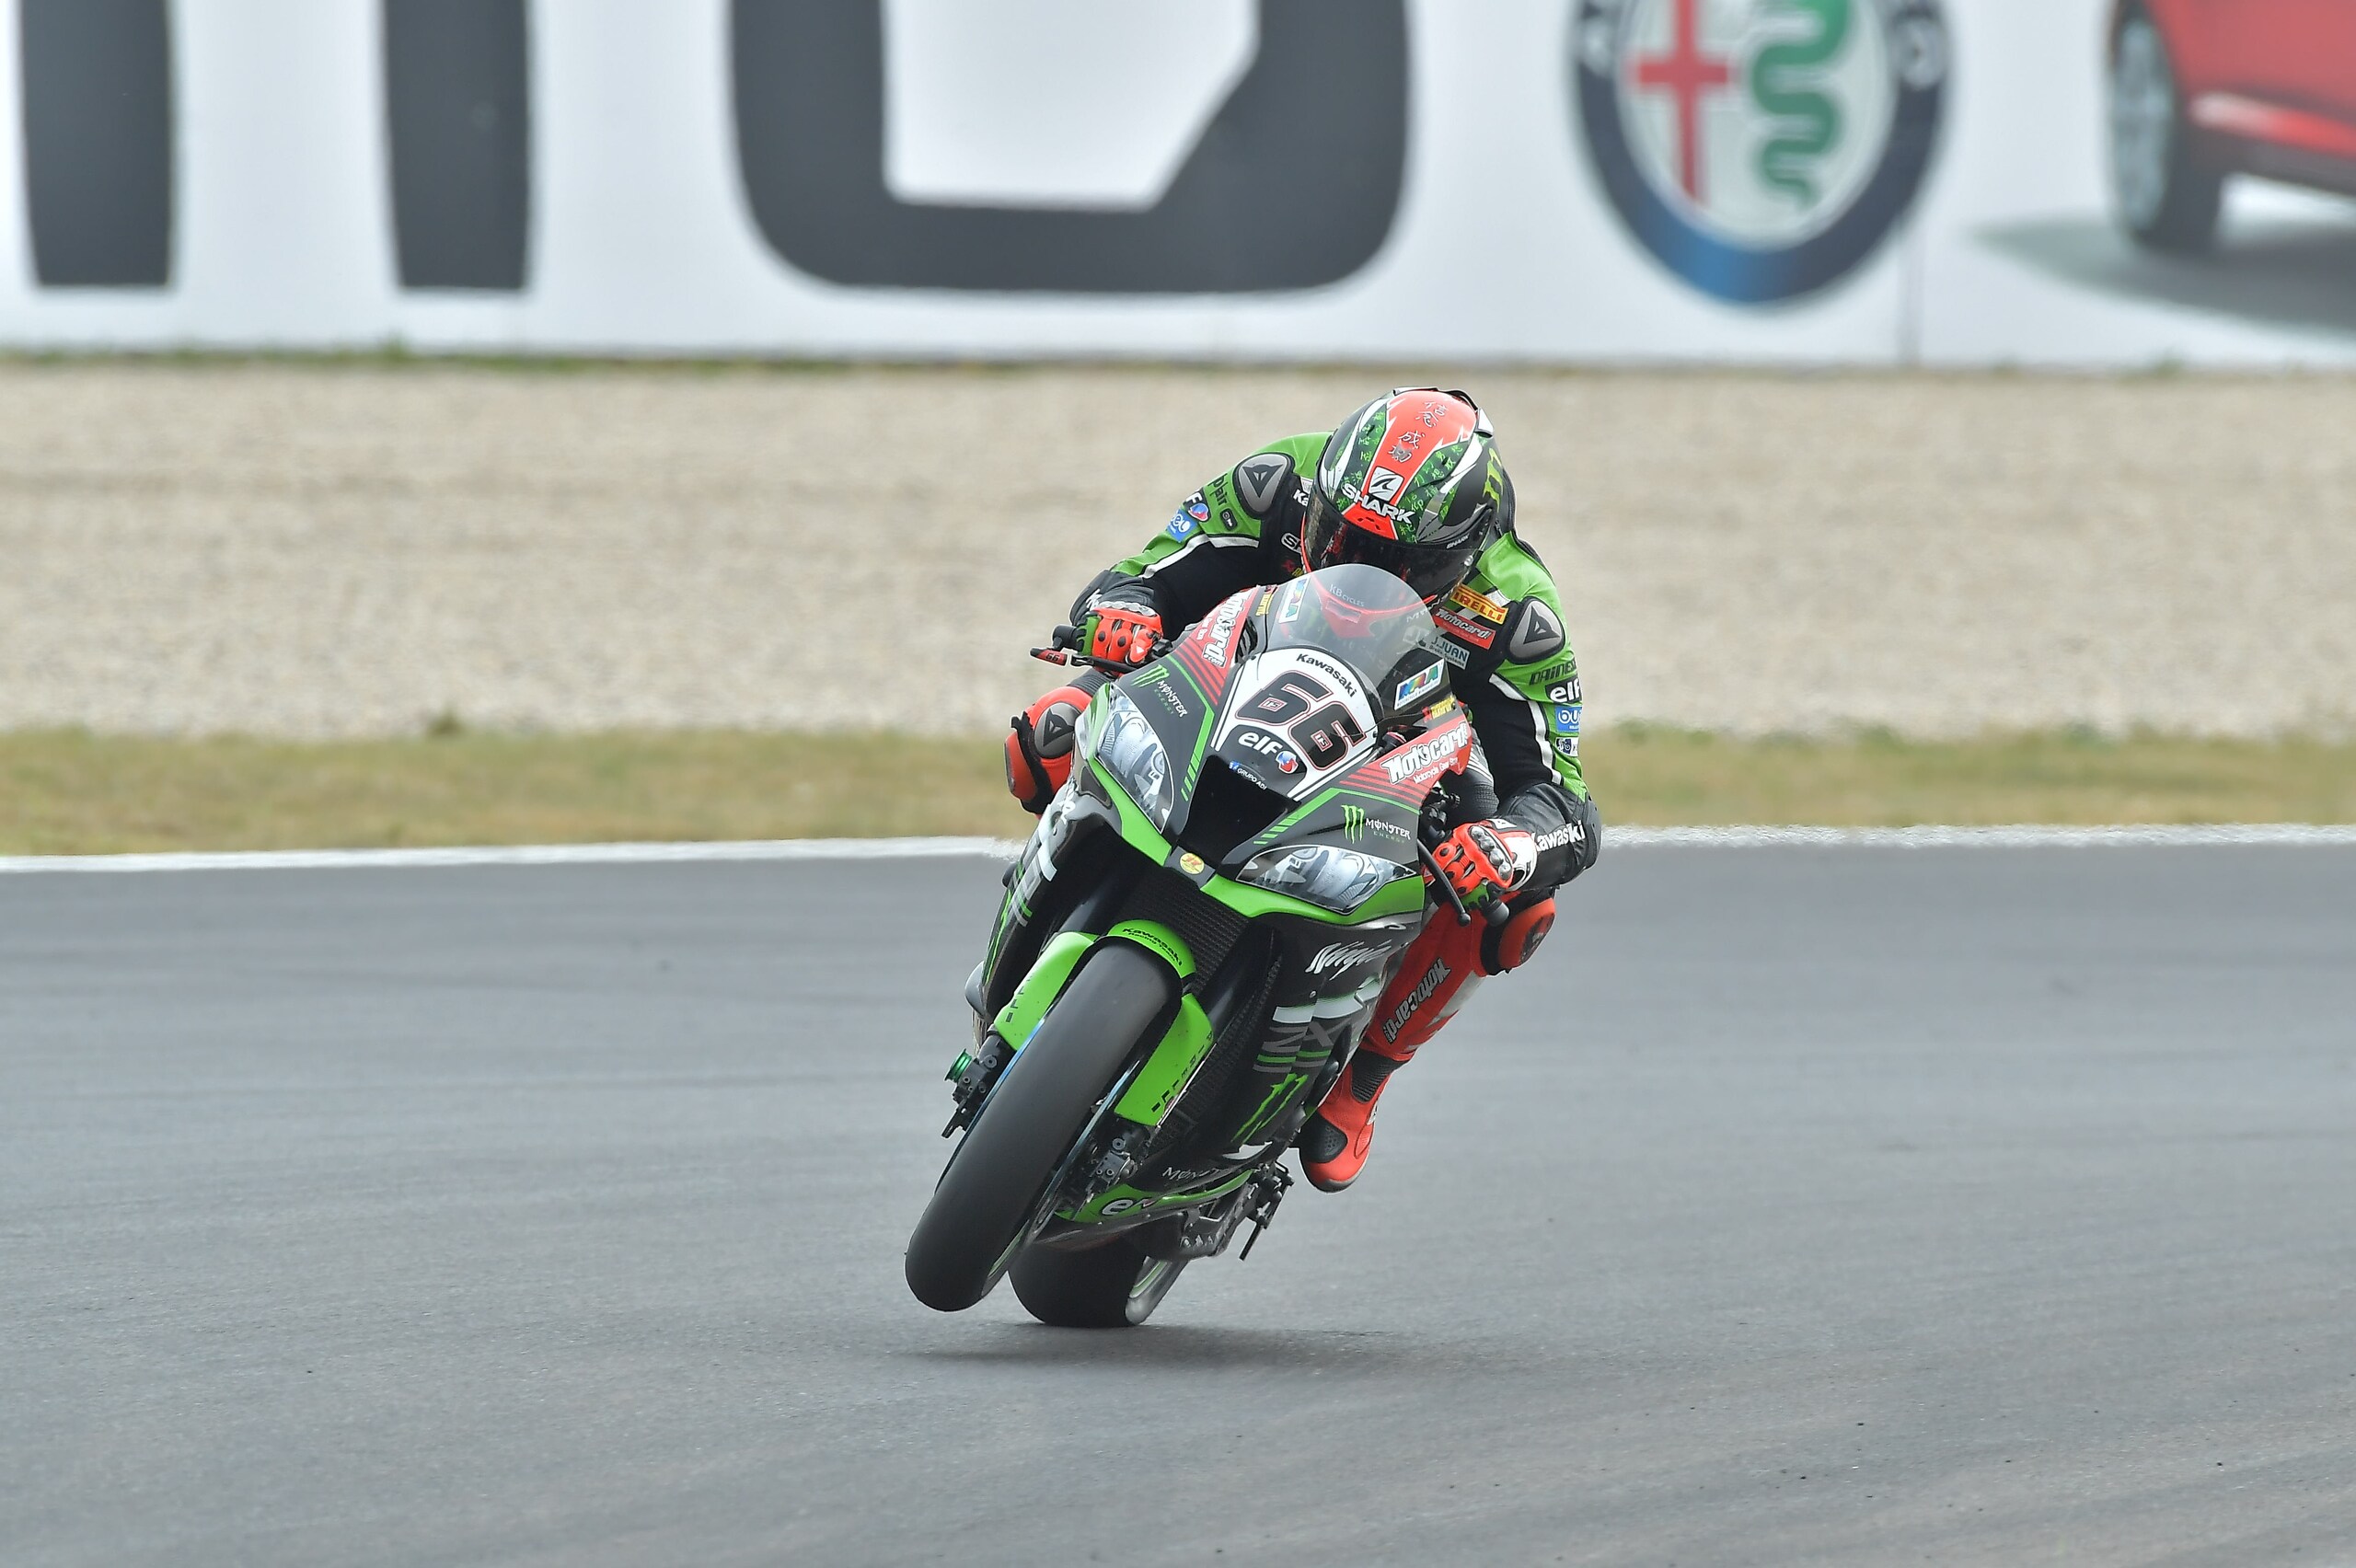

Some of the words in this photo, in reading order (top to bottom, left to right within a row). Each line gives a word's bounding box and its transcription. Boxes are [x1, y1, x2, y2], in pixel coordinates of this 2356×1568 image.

[1342, 482, 1415, 525] SHARK
[1330, 583, 1343, 596] KB
[1342, 594, 1365, 607] CYCLES
[1454, 589, 1505, 621] IRELLI
[1045, 652, 1060, 662] 66
[1296, 653, 1357, 698] Kawasaki
[1235, 670, 1367, 771] 66
[1238, 732, 1284, 755] elf
[1237, 767, 1257, 782] GRUPO
[1255, 779, 1267, 790] ADI
